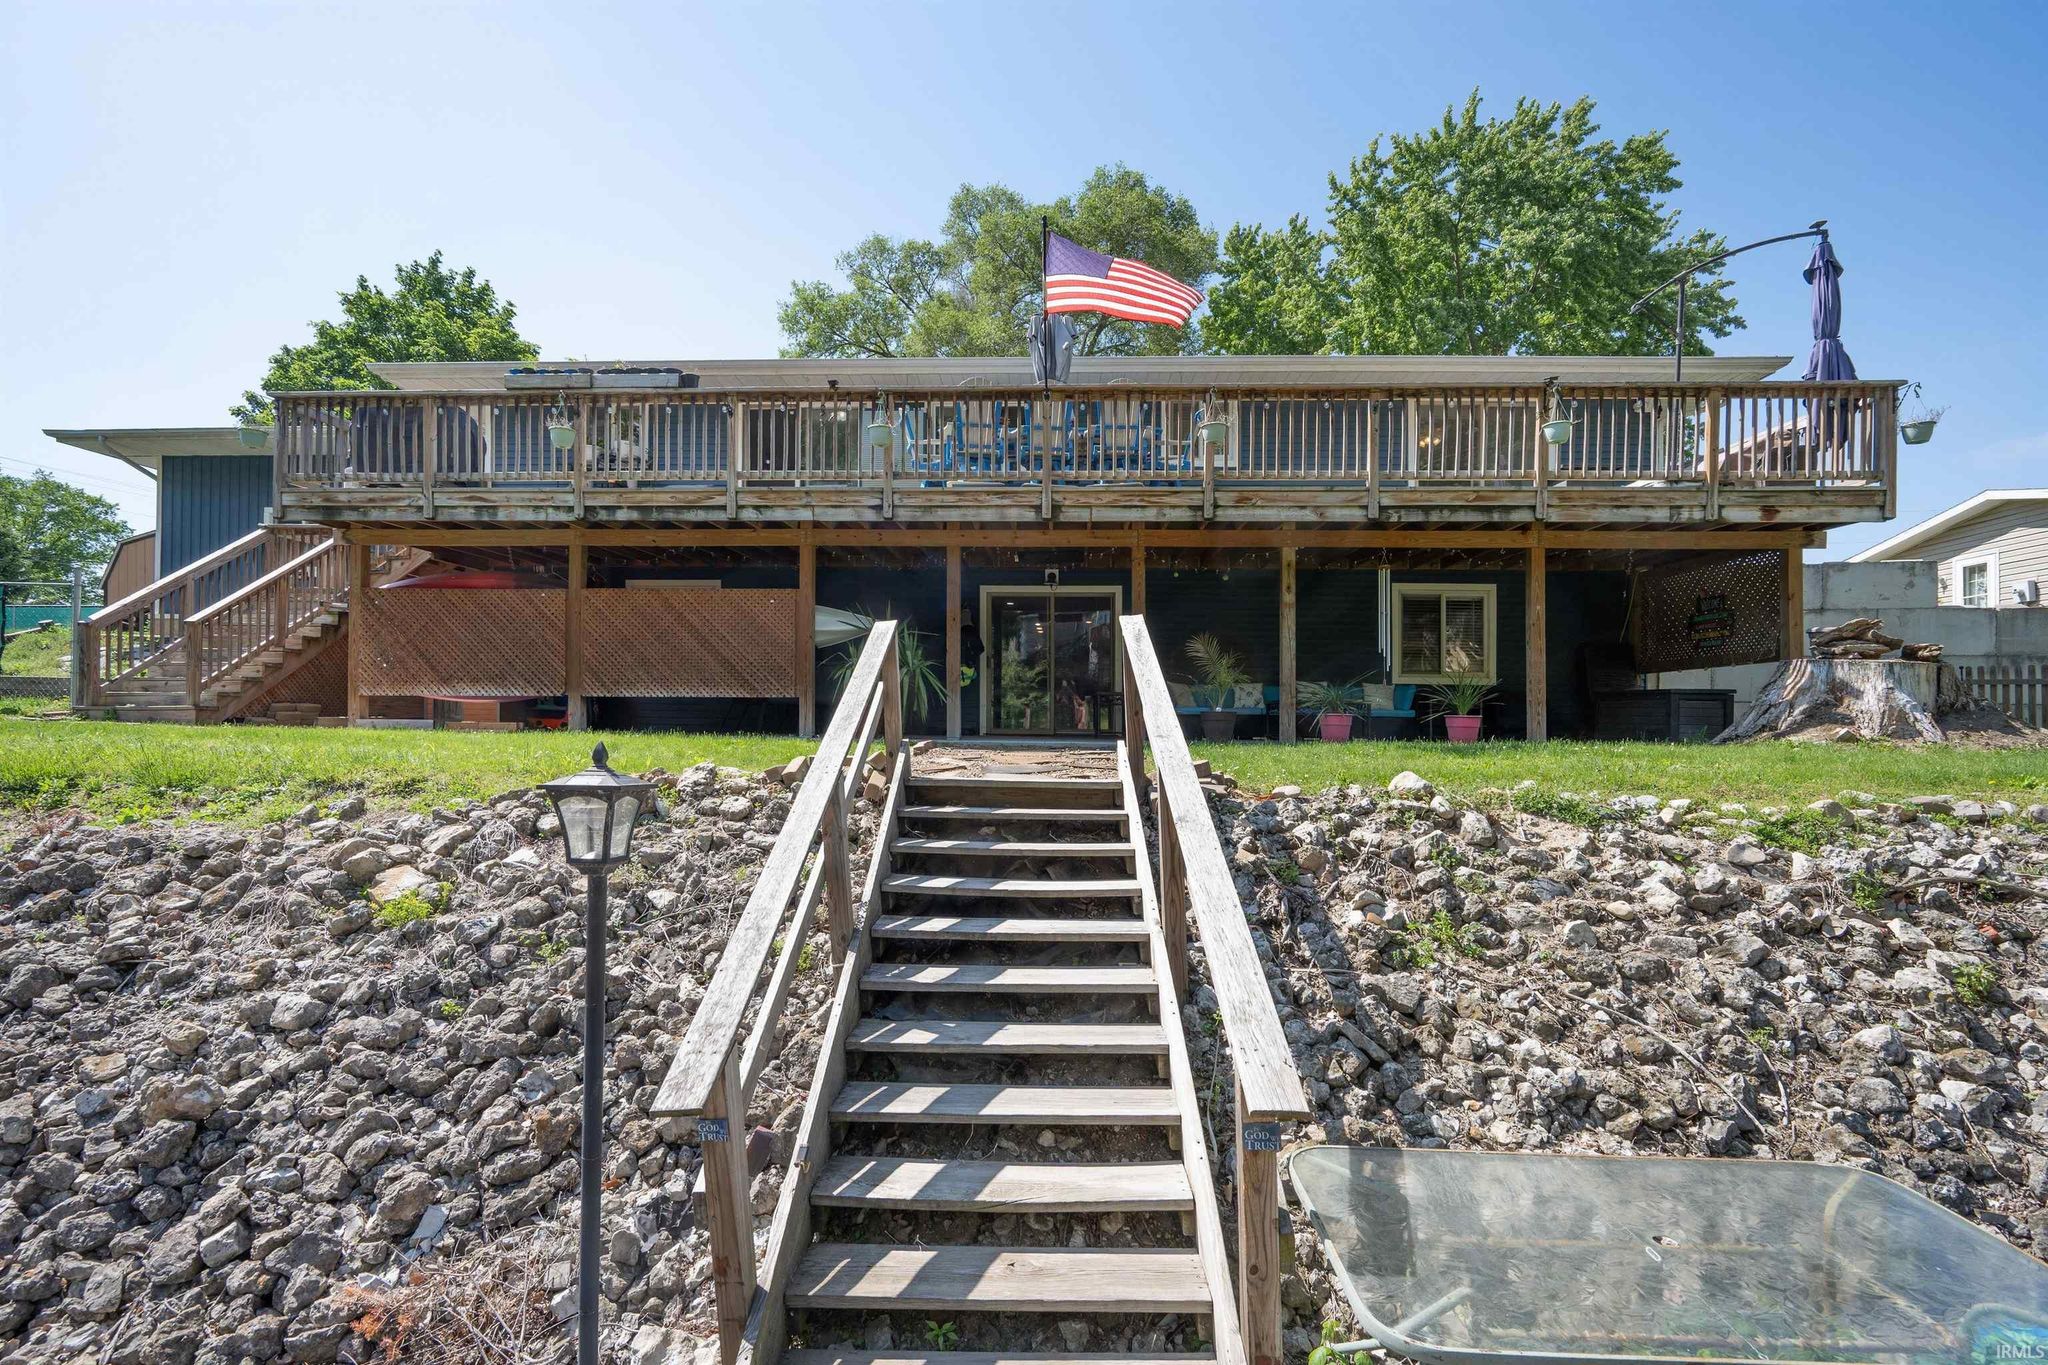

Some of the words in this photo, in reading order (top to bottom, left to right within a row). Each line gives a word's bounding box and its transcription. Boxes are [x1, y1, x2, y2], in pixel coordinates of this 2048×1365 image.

[697, 1123, 719, 1132] GOD
[698, 1131, 728, 1142] TRUST
[1244, 1129, 1269, 1140] GOD
[1244, 1139, 1280, 1151] TRUST
